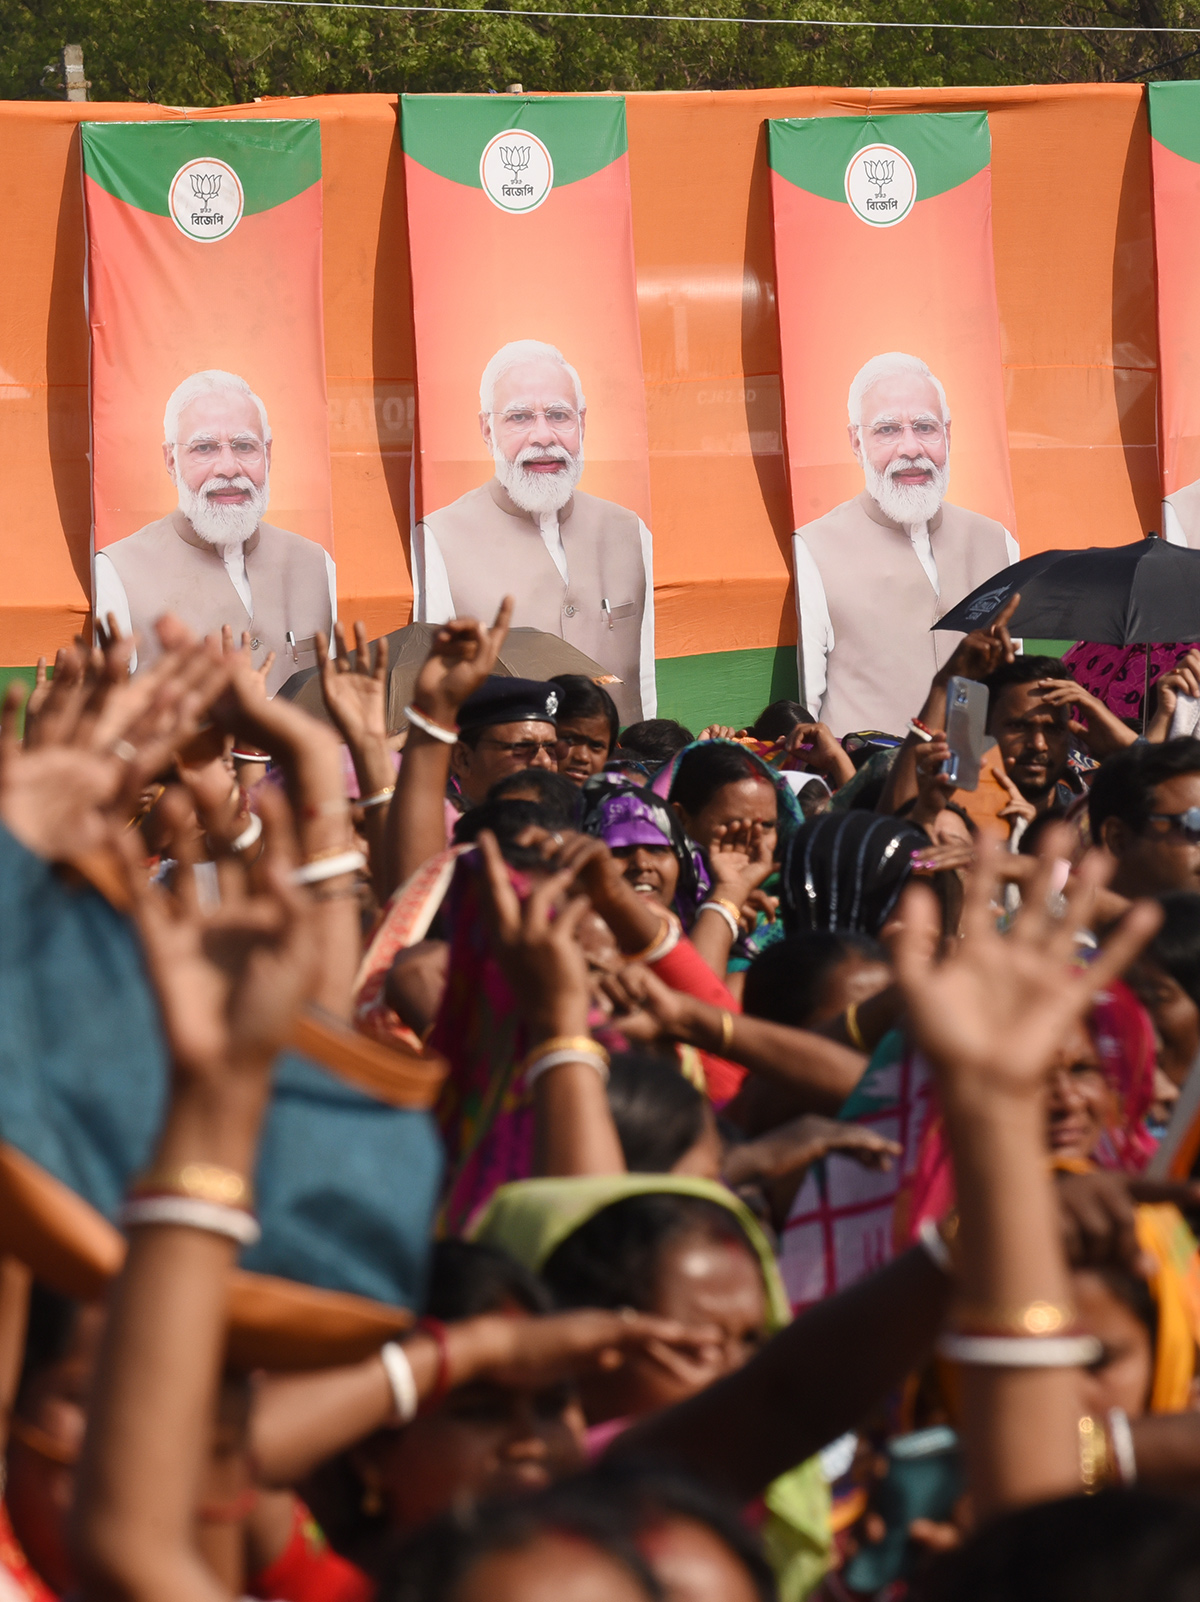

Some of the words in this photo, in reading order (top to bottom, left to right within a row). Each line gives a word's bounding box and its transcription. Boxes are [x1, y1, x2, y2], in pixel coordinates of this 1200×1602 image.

[502, 184, 534, 197] বিজেপি
[867, 198, 898, 211] বিজেপি
[191, 212, 224, 225] বিজেপি
